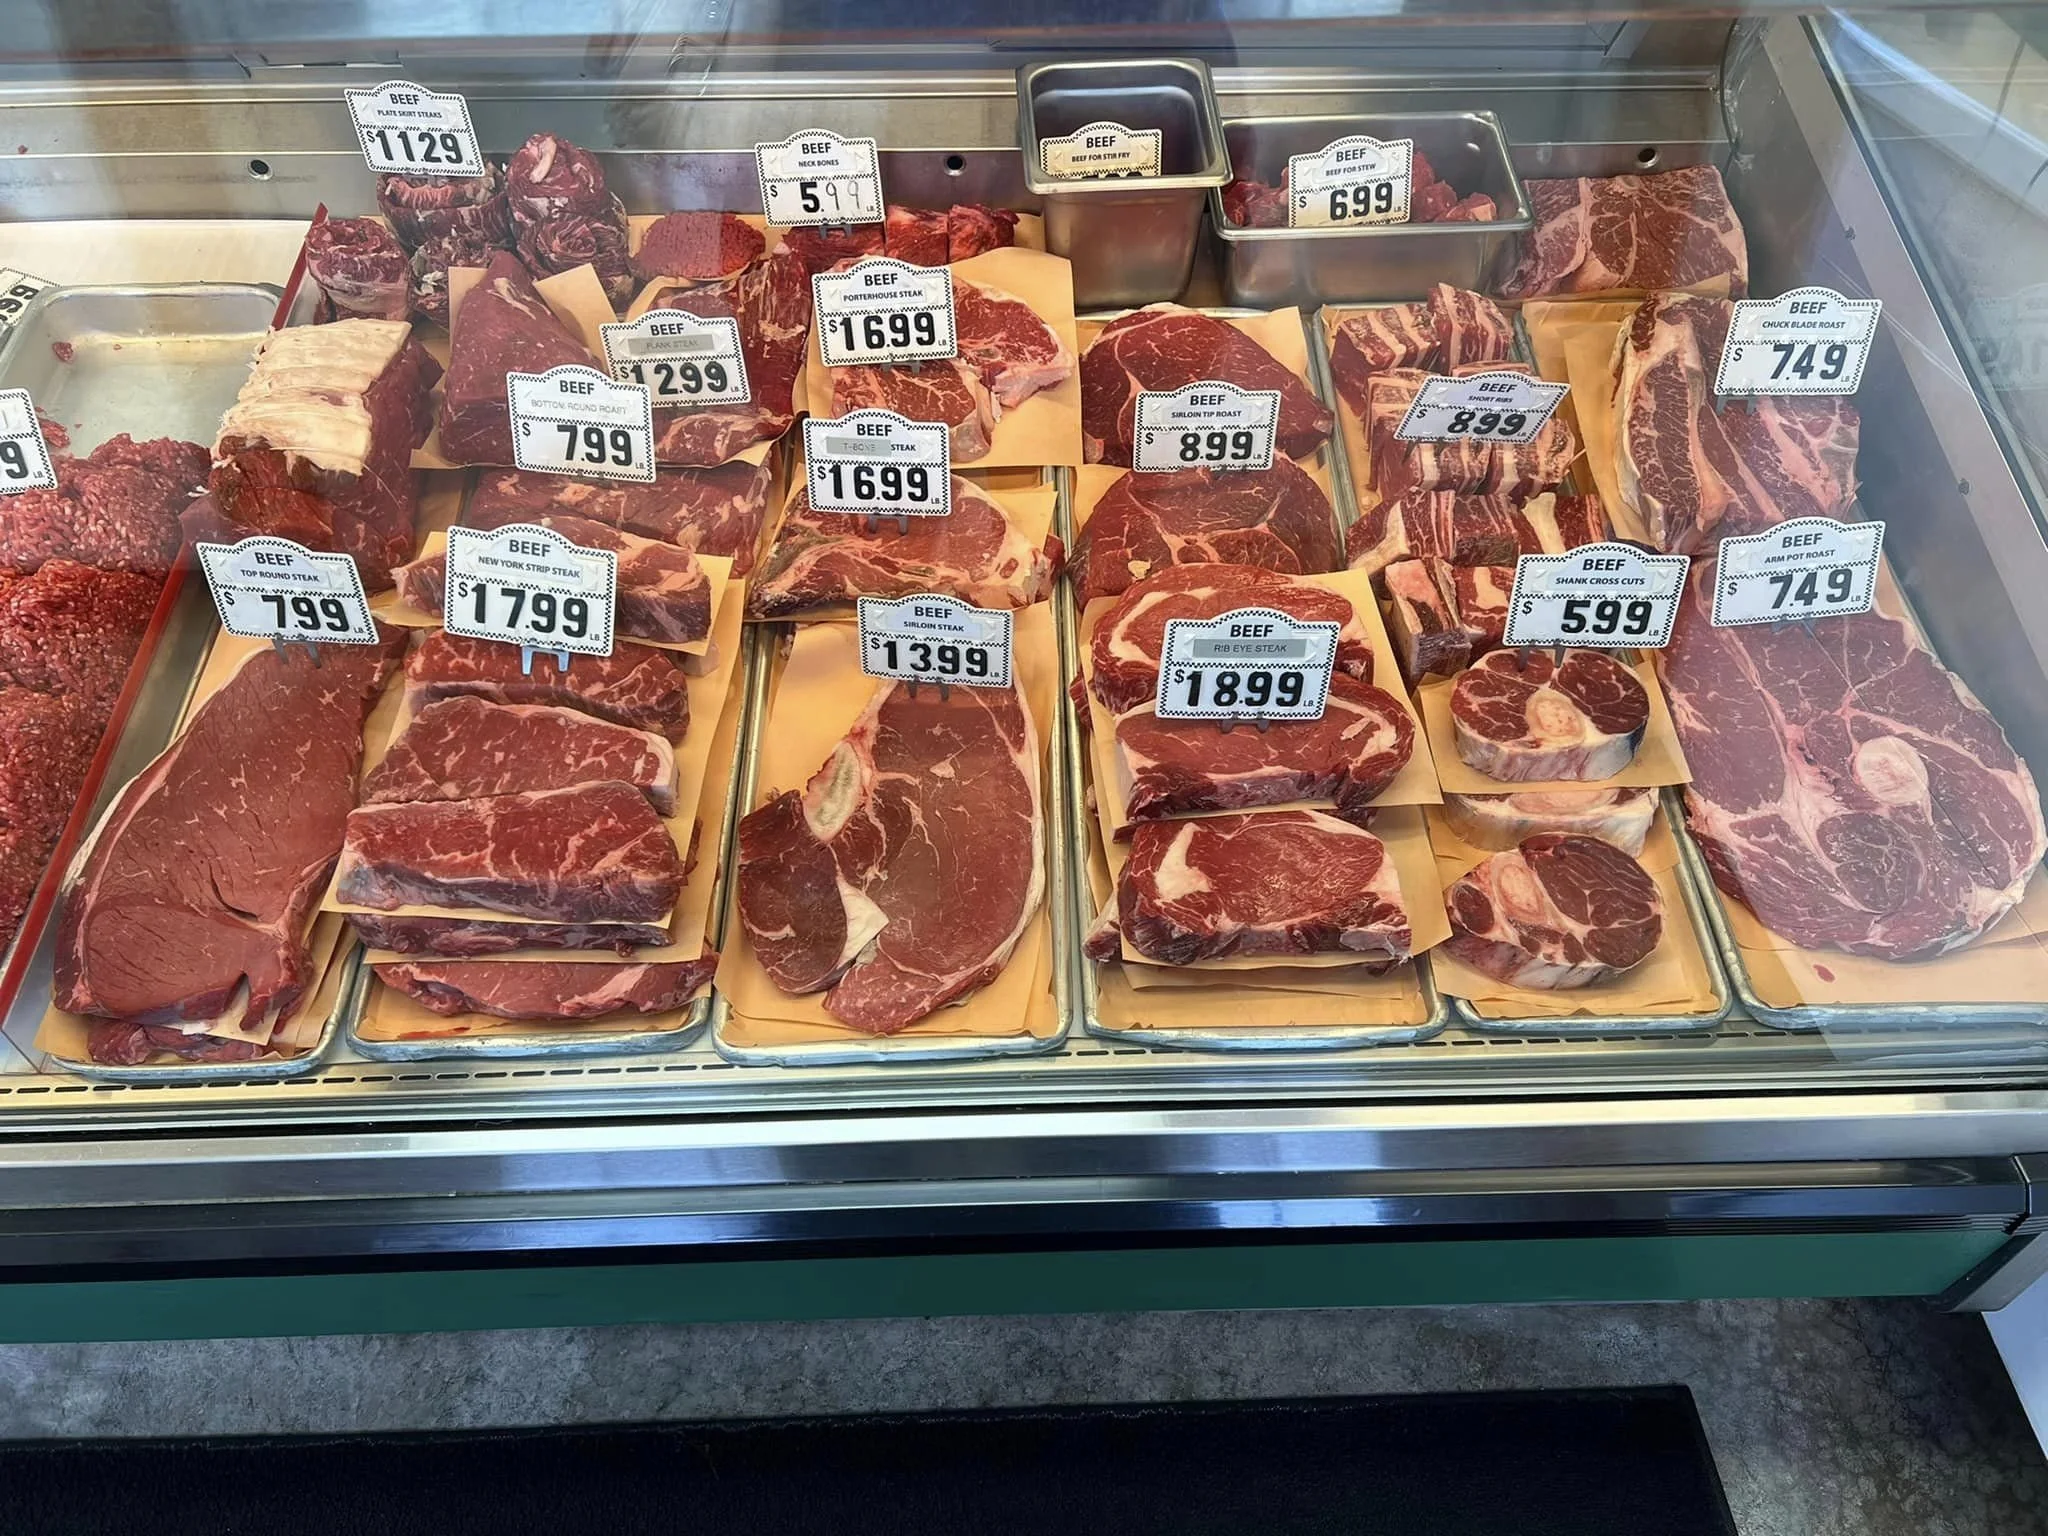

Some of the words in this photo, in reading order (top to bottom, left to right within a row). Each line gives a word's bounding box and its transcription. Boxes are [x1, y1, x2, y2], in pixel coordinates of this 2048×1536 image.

[390, 93, 420, 105] BEEF
[377, 109, 397, 117] PLATE
[398, 110, 417, 118] SKIRT
[418, 110, 442, 118] STEAKS
[802, 142, 831, 154] BEEF
[1086, 135, 1116, 149] BEEF
[1071, 155, 1087, 163] BEEF
[1088, 154, 1102, 162] FOR
[1103, 152, 1117, 160] STIR
[1118, 151, 1131, 159] FRY
[1336, 148, 1367, 162] BEEF
[798, 160, 816, 168] NECK
[817, 159, 839, 167] BONES
[1325, 168, 1342, 176] BEEF
[1343, 166, 1357, 174] FOR
[1357, 163, 1377, 172] STEW
[770, 184, 778, 198] $
[800, 180, 860, 213] 5.99
[1299, 195, 1307, 208] $
[1330, 182, 1393, 221] 6.99
[864, 273, 898, 286] BEEF
[843, 290, 898, 302] PORTERHOUSE
[899, 289, 924, 298] STEAK
[1789, 301, 1827, 314] BEEF
[650, 323, 684, 336] BEEF
[1762, 320, 1789, 329] CHUCK
[1790, 320, 1818, 329] BLADE
[1819, 320, 1846, 329] ROAST
[1733, 347, 1744, 362] $
[1770, 343, 1848, 380] 7.49
[559, 380, 594, 395] BEEF
[1479, 382, 1517, 393] BEEF
[531, 399, 565, 409] BOTTOM
[567, 402, 597, 412] ROUND
[599, 405, 627, 414] ROAST
[1190, 394, 1226, 406] BEEF
[1416, 408, 1428, 419] $
[1447, 411, 1527, 436] 8.99
[857, 423, 892, 436] BEEF
[522, 422, 531, 437] $
[557, 424, 632, 467] 7.99
[891, 443, 916, 451] STEAK
[1145, 432, 1154, 445] $
[1180, 431, 1253, 462] 8.99
[1782, 533, 1823, 548] BEEF
[509, 539, 551, 557] BEEF
[255, 552, 294, 566] BEEF
[1764, 555, 1785, 564] ARM
[1786, 552, 1805, 561] POT
[1806, 549, 1836, 559] ROAST
[478, 556, 500, 566] NEW
[500, 559, 524, 570] YORK
[525, 563, 551, 573] STRIP
[552, 567, 581, 578] STEAK
[1582, 558, 1626, 571] BEEF
[240, 569, 258, 577] TOP
[259, 571, 291, 580] ROUND
[292, 573, 320, 582] STEAK
[1555, 577, 1588, 585] SHANK
[1589, 577, 1619, 585] CROSS
[1621, 577, 1645, 586] CUTS
[1727, 581, 1738, 596] $
[1769, 568, 1853, 610] 7.49
[223, 591, 235, 606] $
[261, 594, 350, 632] 7.99
[914, 606, 952, 618] BEEF
[1522, 600, 1533, 615] $
[1561, 599, 1653, 635] 5.99
[904, 621, 937, 630] SIRLOIN
[937, 623, 965, 632] STEAK
[1230, 625, 1273, 637] BEEF
[1213, 644, 1230, 652] RIB
[1232, 644, 1253, 652] EYE
[1255, 644, 1287, 653] STEAK
